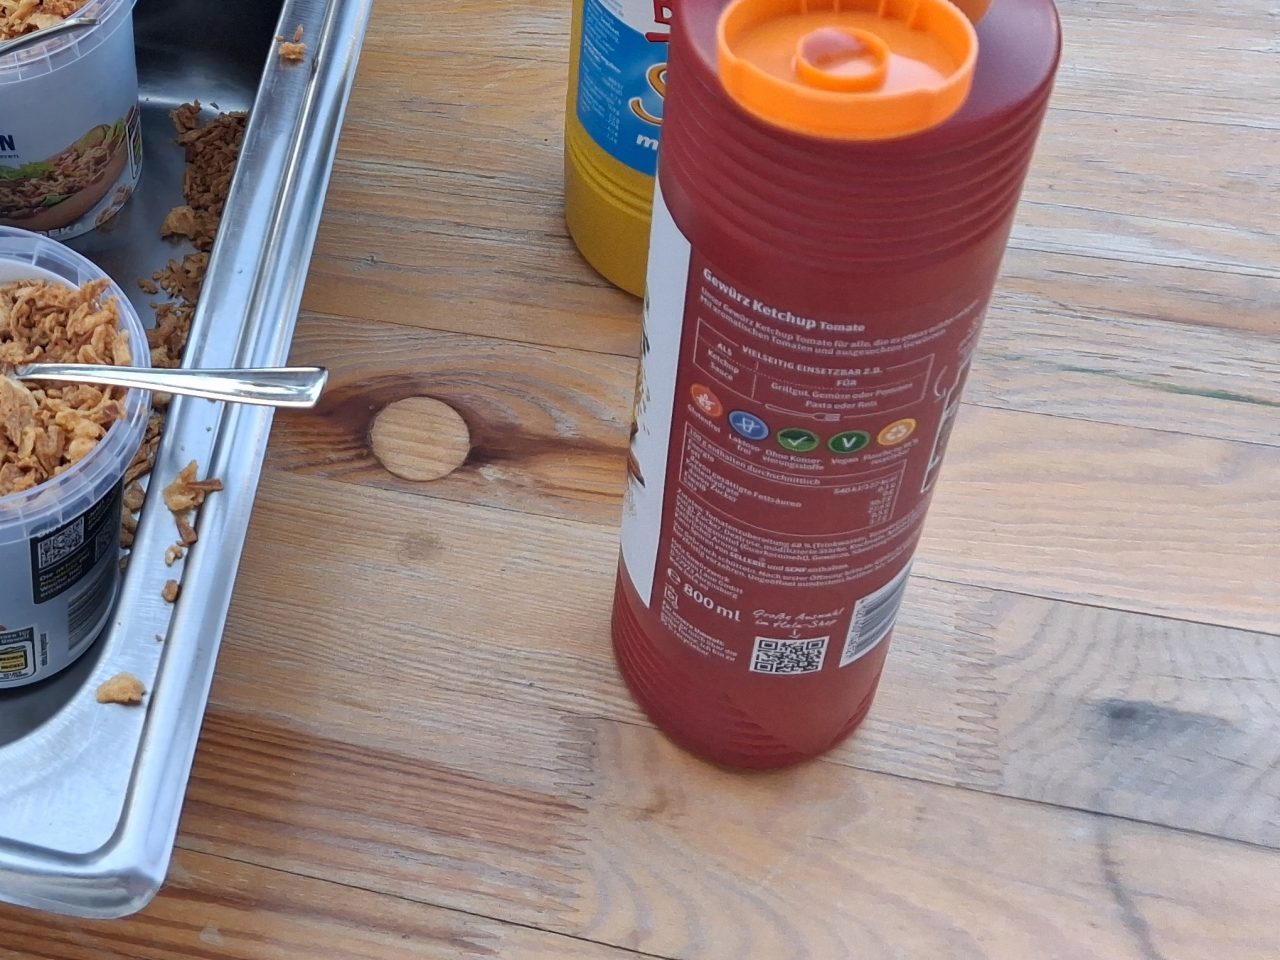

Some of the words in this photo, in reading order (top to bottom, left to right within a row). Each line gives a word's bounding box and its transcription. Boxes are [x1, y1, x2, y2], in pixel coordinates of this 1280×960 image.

[703, 267, 751, 308] Gewürz
[752, 299, 817, 331] Ketchup
[820, 320, 866, 333] Tomate
[754, 320, 794, 341] Ketchup
[717, 343, 733, 357] ALS
[771, 335, 814, 353] Tomaten
[707, 349, 740, 375] Ketchup
[741, 344, 795, 370] VIELSEITIG
[796, 364, 862, 377] EINSETZBAR
[836, 378, 857, 387] FÜR
[805, 400, 832, 408] Pasta
[683, 583, 714, 610] 800
[716, 604, 741, 621] ml
